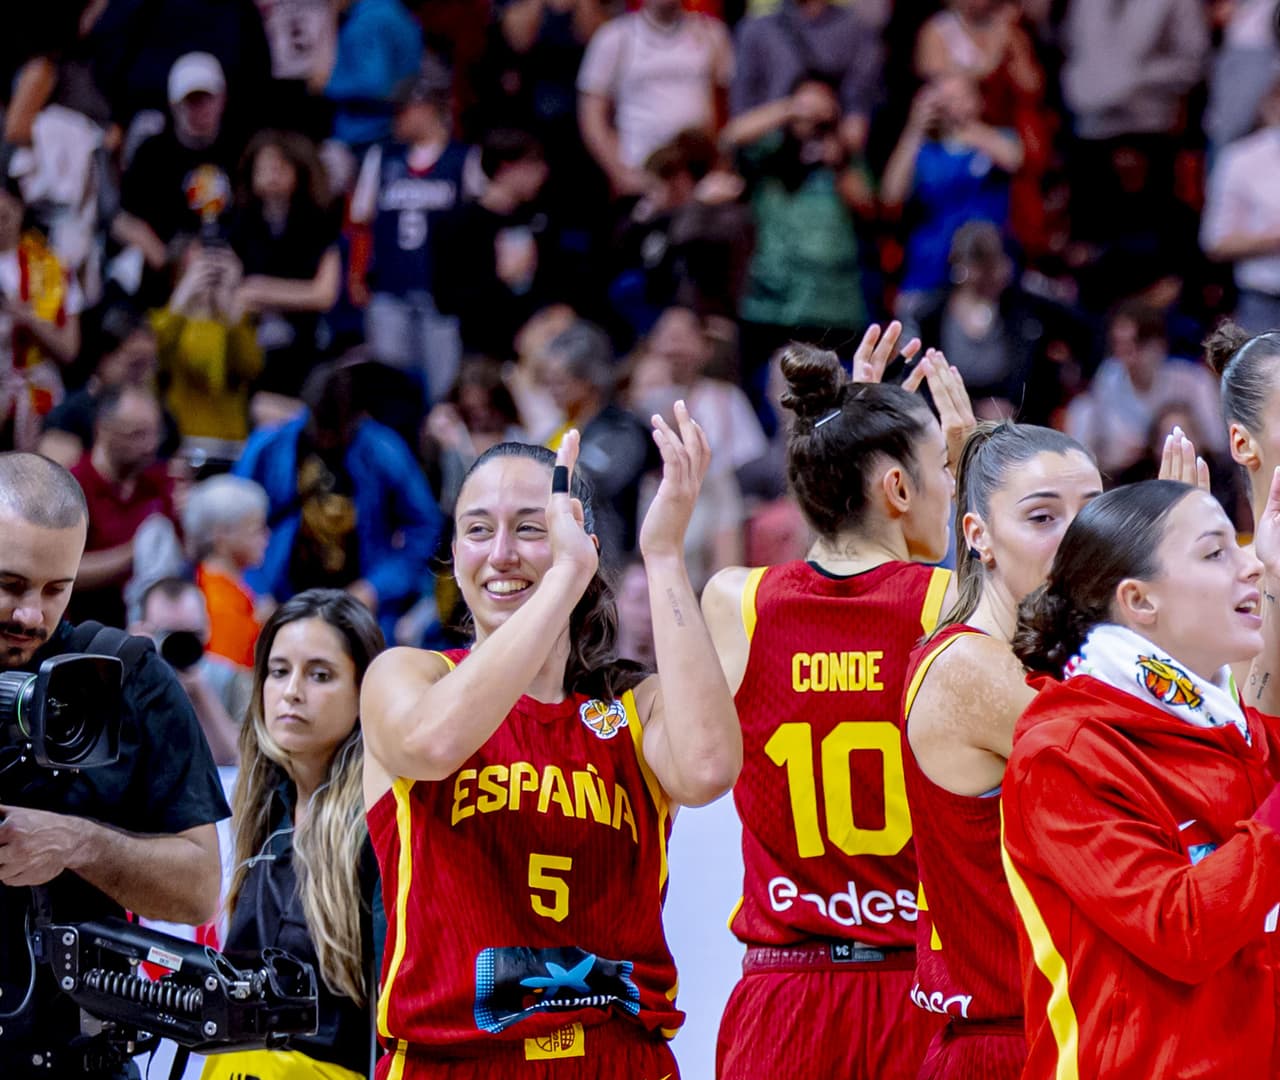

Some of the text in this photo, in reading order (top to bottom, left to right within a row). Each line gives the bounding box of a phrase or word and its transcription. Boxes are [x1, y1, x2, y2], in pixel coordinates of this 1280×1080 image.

[792, 651, 884, 692] CONDE
[451, 761, 639, 844] ESPAÑA
[764, 721, 913, 859] 10
[528, 853, 573, 923] 5
